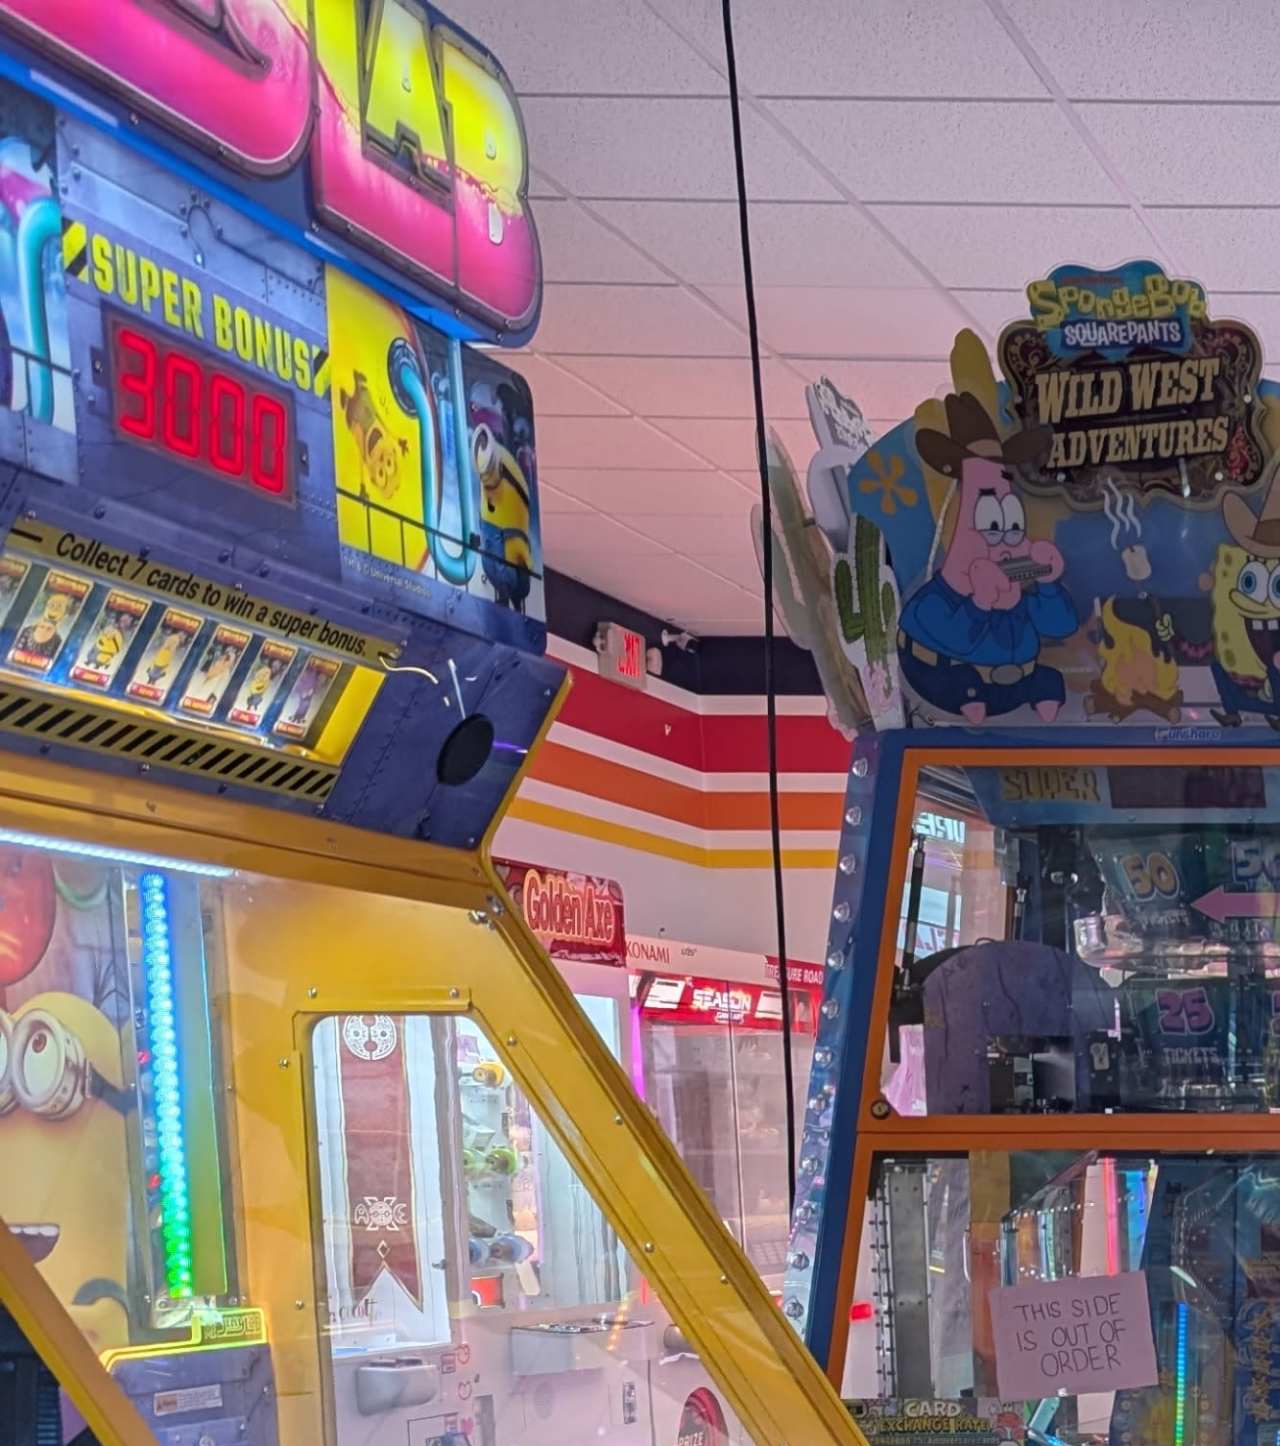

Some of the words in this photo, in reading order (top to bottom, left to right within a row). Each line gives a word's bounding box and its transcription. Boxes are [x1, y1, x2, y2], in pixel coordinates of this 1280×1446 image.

[91, 233, 204, 339] SUPER
[213, 293, 311, 390] BONUS
[1026, 273, 1207, 331] SpongeBob
[1064, 319, 1181, 347] SQUAREPANTS
[1035, 369, 1123, 425] WILD
[1129, 357, 1221, 410] WEST
[118, 328, 286, 494] 3000
[1046, 415, 1229, 469] ADVENTURES
[56, 531, 132, 583] Collect
[134, 559, 147, 582] 7
[147, 566, 202, 600] cards
[201, 584, 221, 607] to
[223, 594, 256, 619] win
[255, 608, 267, 622] a
[268, 609, 318, 640] super
[319, 619, 367, 657] bonus.
[523, 869, 582, 938] Golden
[582, 884, 617, 944] Axe
[625, 941, 671, 965] KONAMI
[766, 963, 803, 984] TREURE
[804, 968, 824, 986] ROAD
[692, 988, 751, 1011] SEASON
[1155, 988, 1214, 1036] 25
[1014, 1300, 1062, 1322] THIS
[1071, 1292, 1121, 1318] SIDE
[1016, 1329, 1038, 1352] IS
[1051, 1322, 1089, 1348] OUT
[1099, 1318, 1127, 1344] OF
[1040, 1343, 1121, 1378] ORDER
[881, 1416, 953, 1432] EXCHANGE
[905, 1400, 962, 1418] CARD
